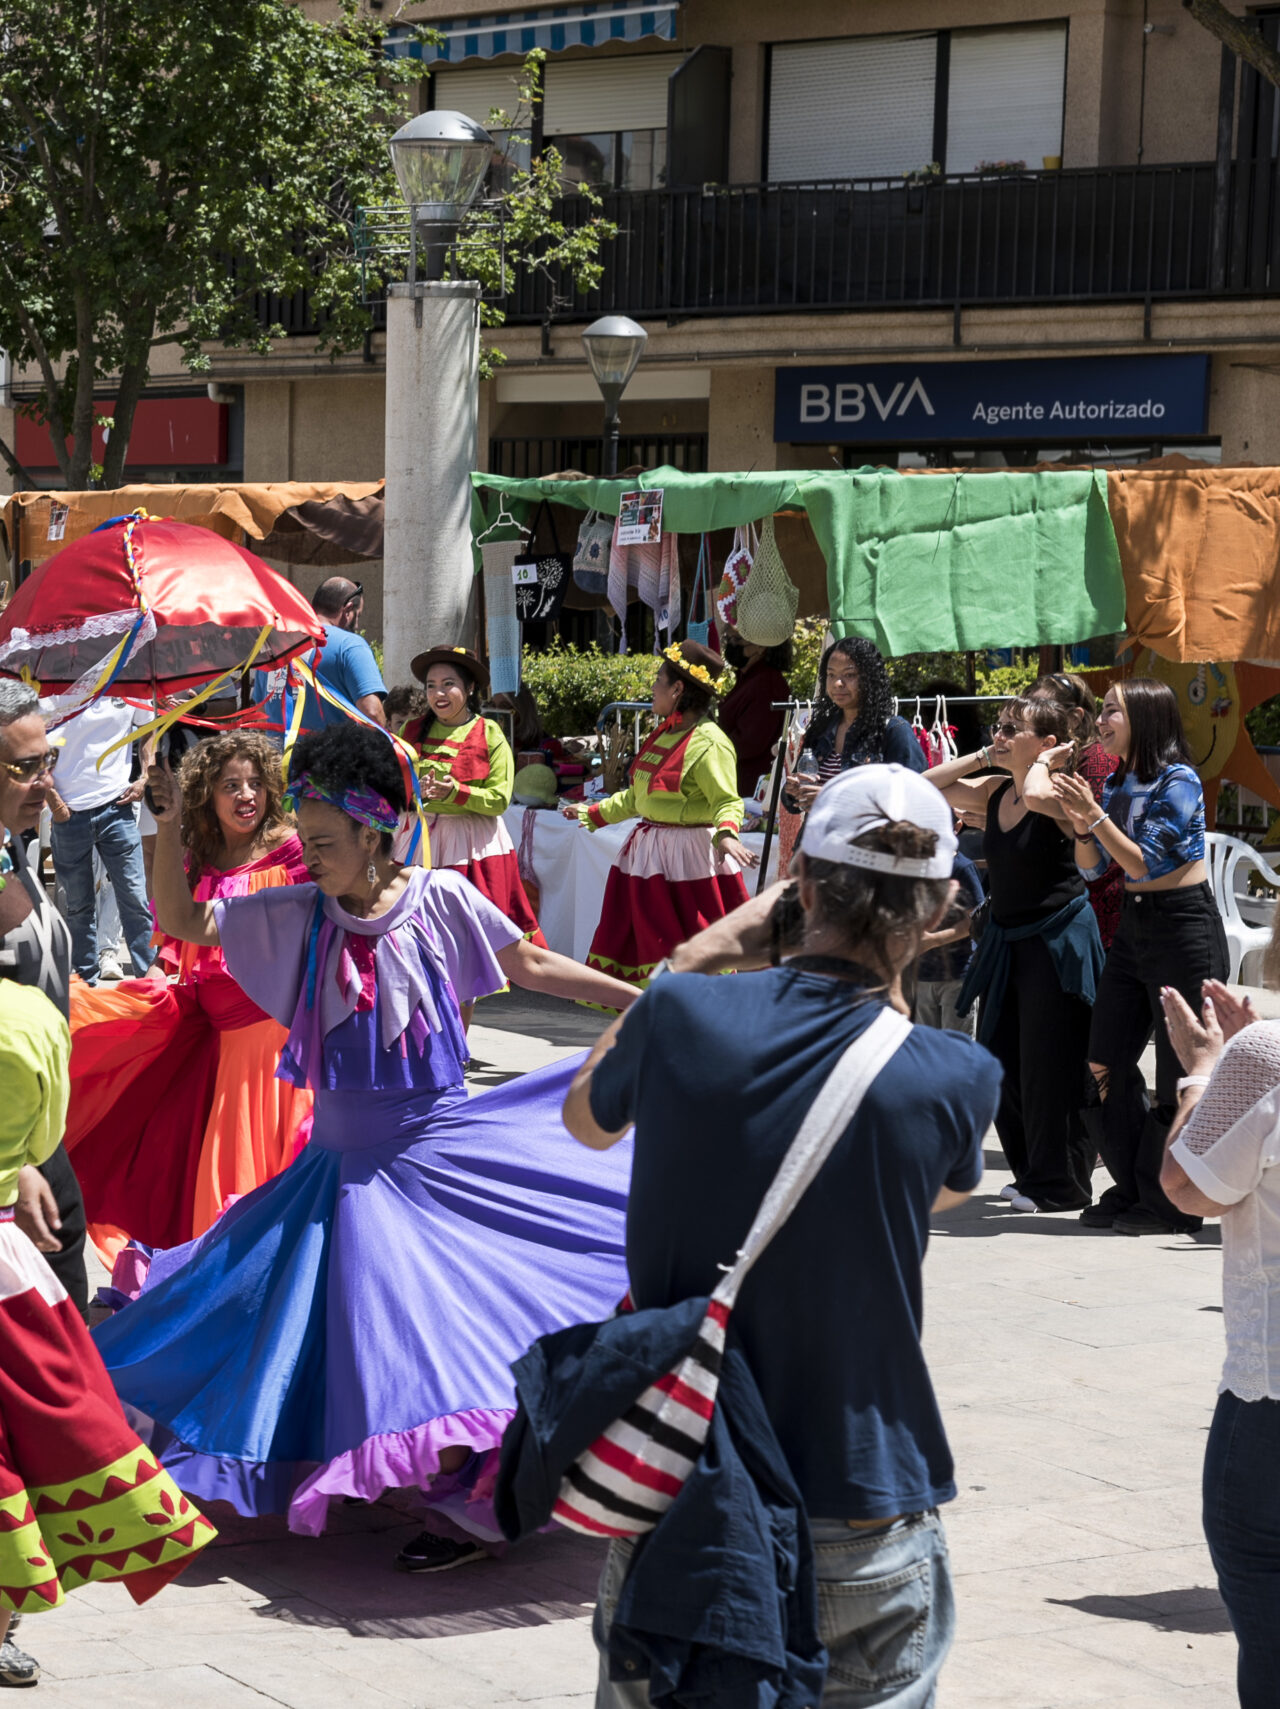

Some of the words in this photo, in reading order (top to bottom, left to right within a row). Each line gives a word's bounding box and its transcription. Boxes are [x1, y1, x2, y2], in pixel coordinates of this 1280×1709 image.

[799, 377, 935, 423] BBVA
[972, 402, 1045, 425] Agente
[1049, 399, 1165, 420] Autorizado
[517, 568, 529, 581] 10
